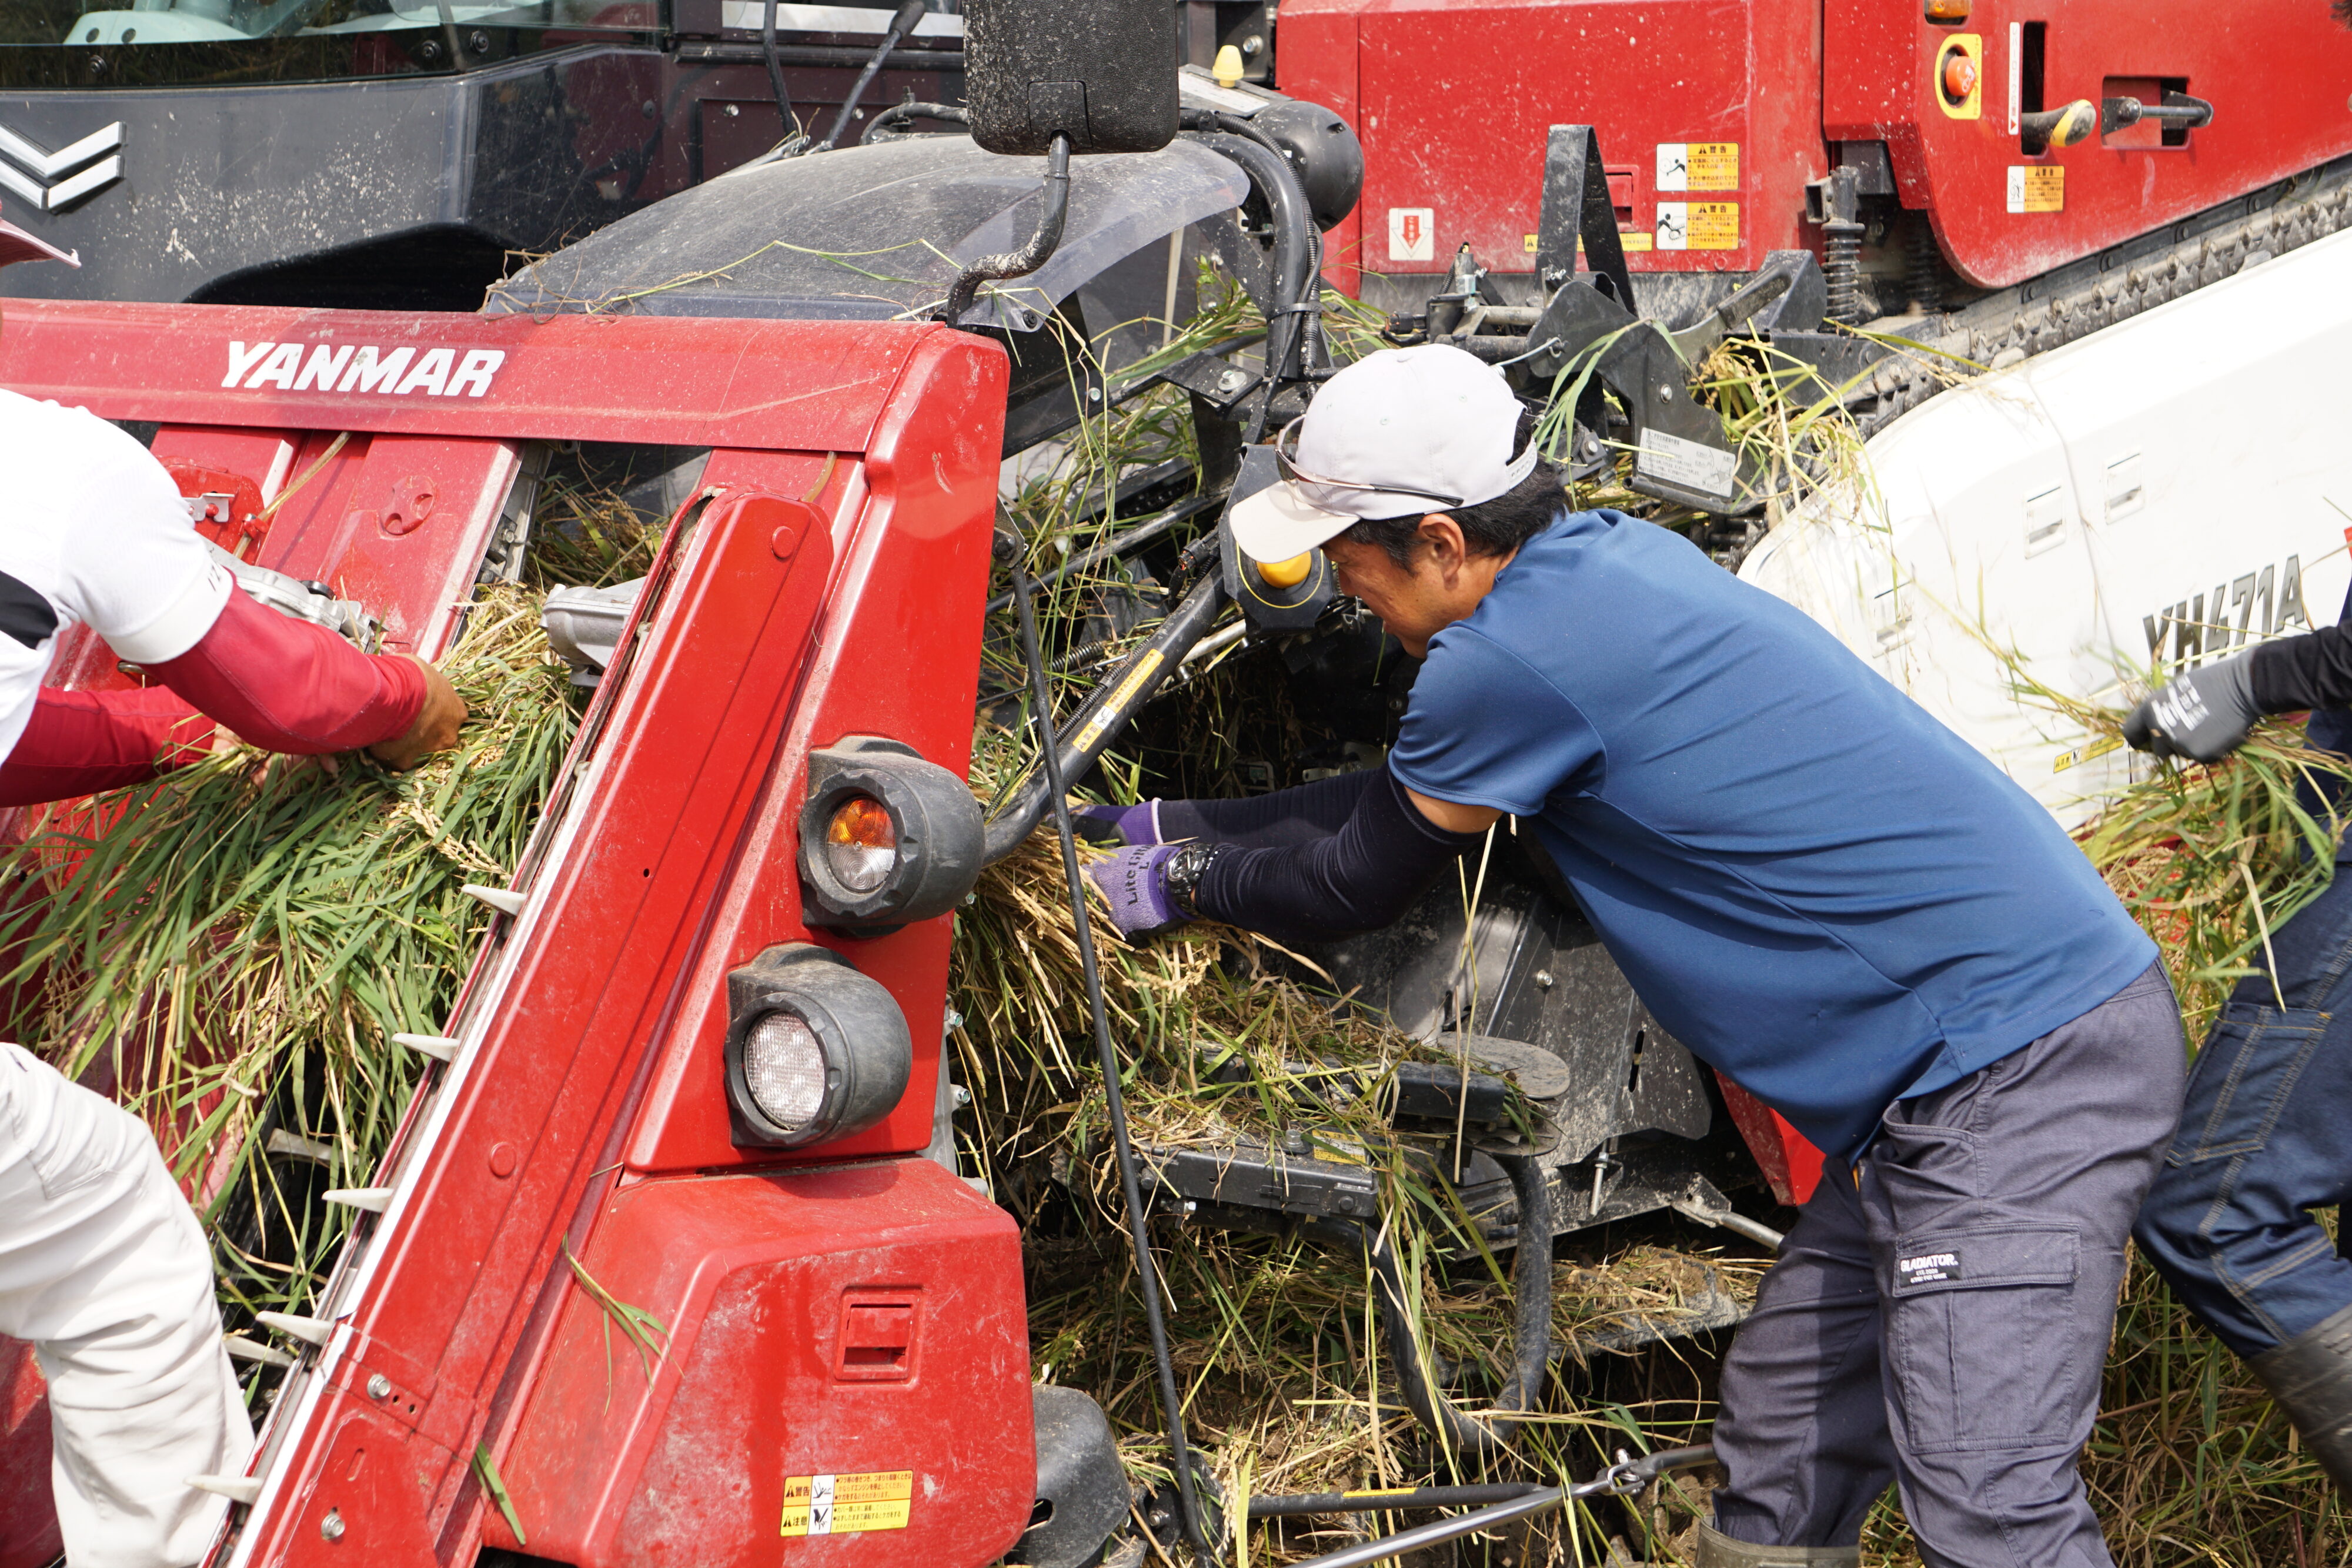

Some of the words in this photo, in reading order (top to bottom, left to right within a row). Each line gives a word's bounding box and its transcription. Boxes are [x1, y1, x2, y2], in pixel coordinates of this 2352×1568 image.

[221, 341, 506, 397] YANMAR
[2142, 553, 2305, 676] YH471A
[1125, 870, 1139, 906] Lite
[795, 1485, 810, 1497] 警告
[793, 1515, 808, 1526] 注意
